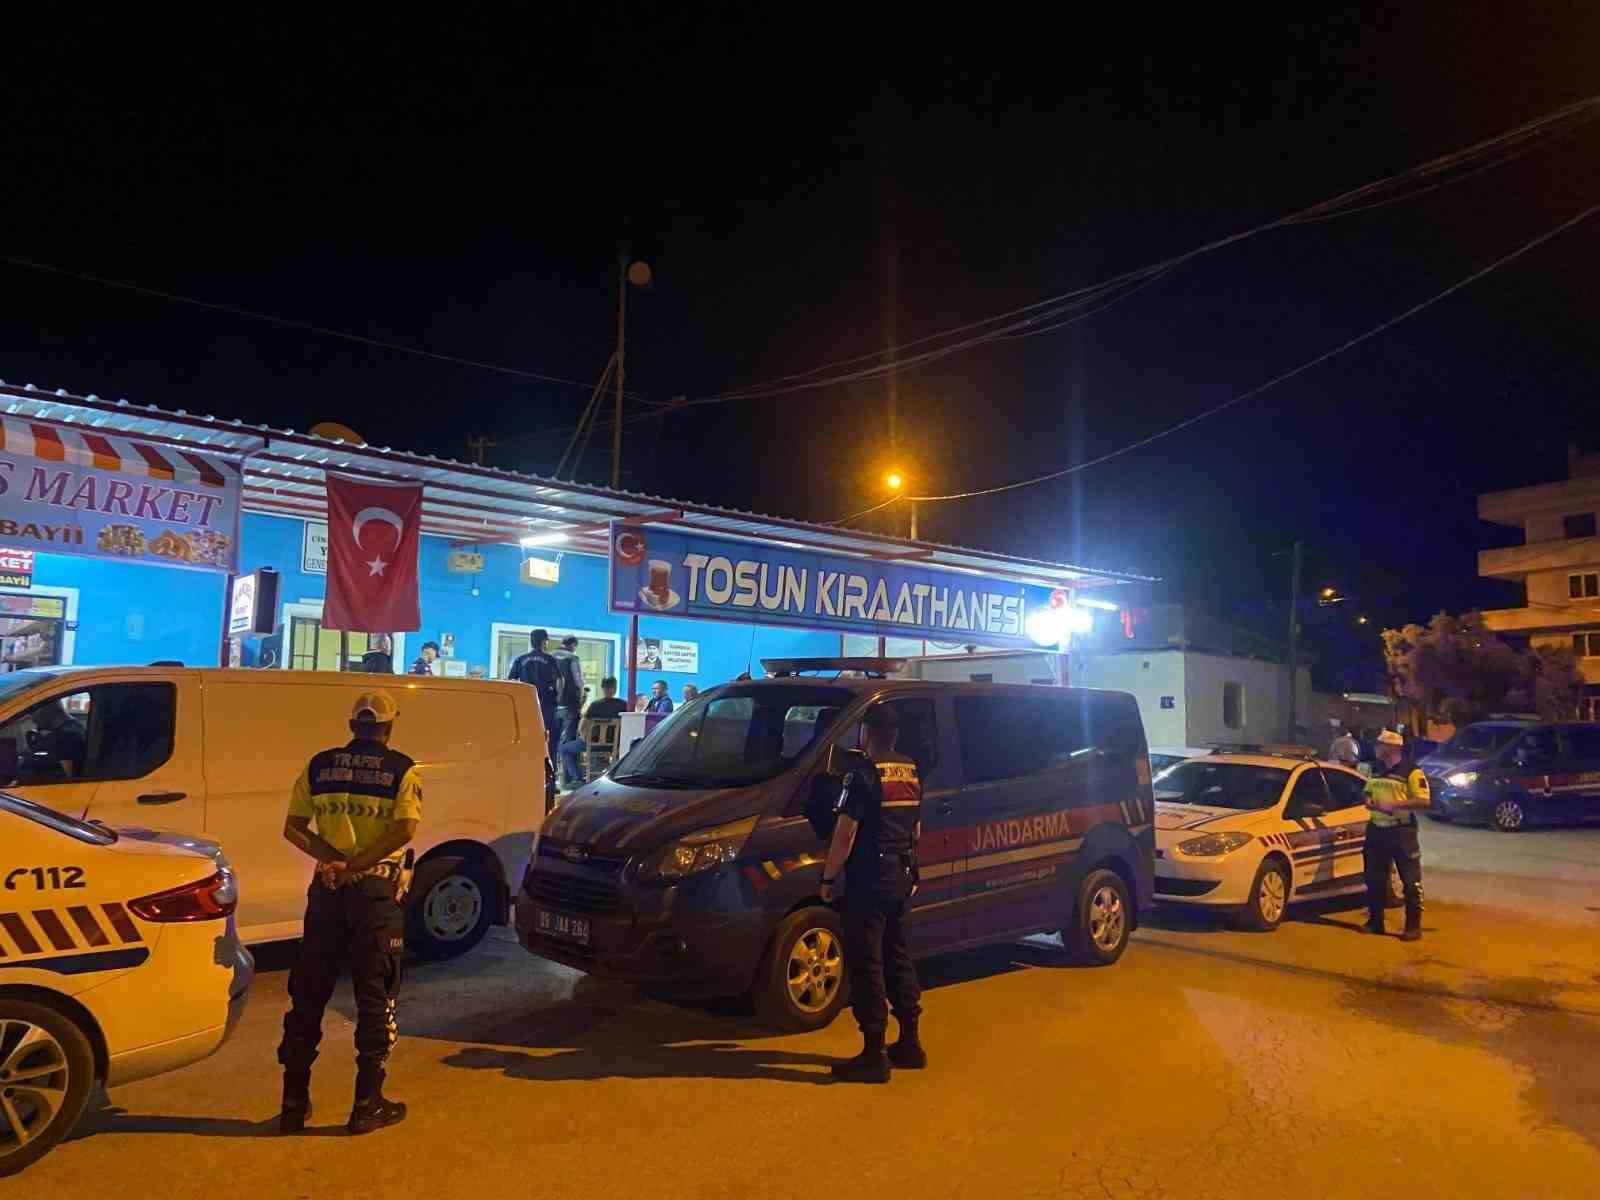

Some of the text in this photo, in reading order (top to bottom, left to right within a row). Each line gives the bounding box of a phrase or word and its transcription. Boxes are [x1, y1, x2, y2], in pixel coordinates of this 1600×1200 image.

[25, 466, 222, 526] MARKET
[683, 553, 1025, 636] TOSUN KIRAATHANESİ
[972, 810, 1070, 851] JANDARMA
[31, 866, 86, 890] 112
